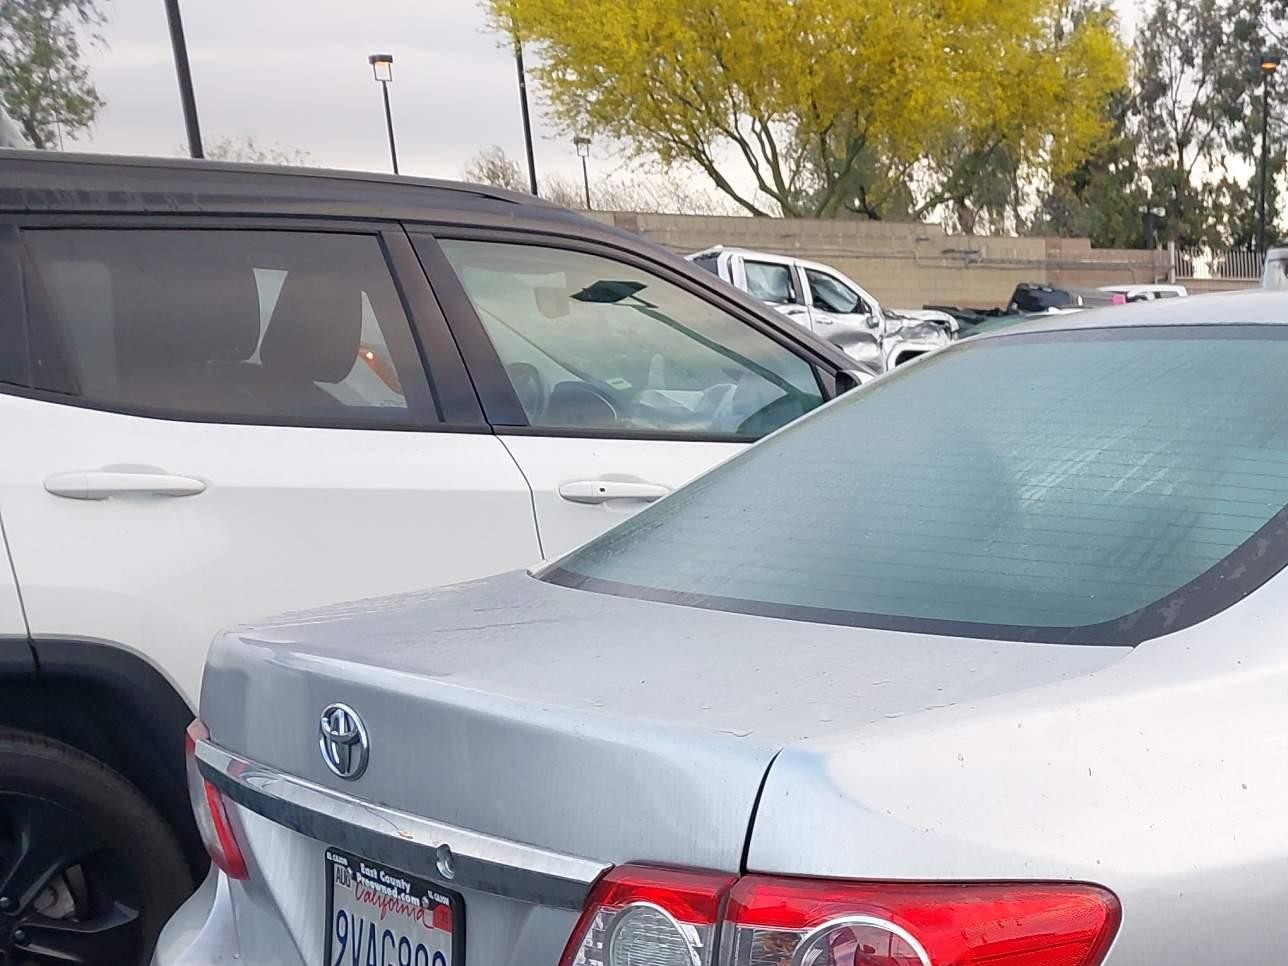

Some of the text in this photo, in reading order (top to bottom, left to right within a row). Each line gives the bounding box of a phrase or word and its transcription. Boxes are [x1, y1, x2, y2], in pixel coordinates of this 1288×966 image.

[355, 872, 420, 906] Preowned.com
[360, 863, 411, 893] East County
